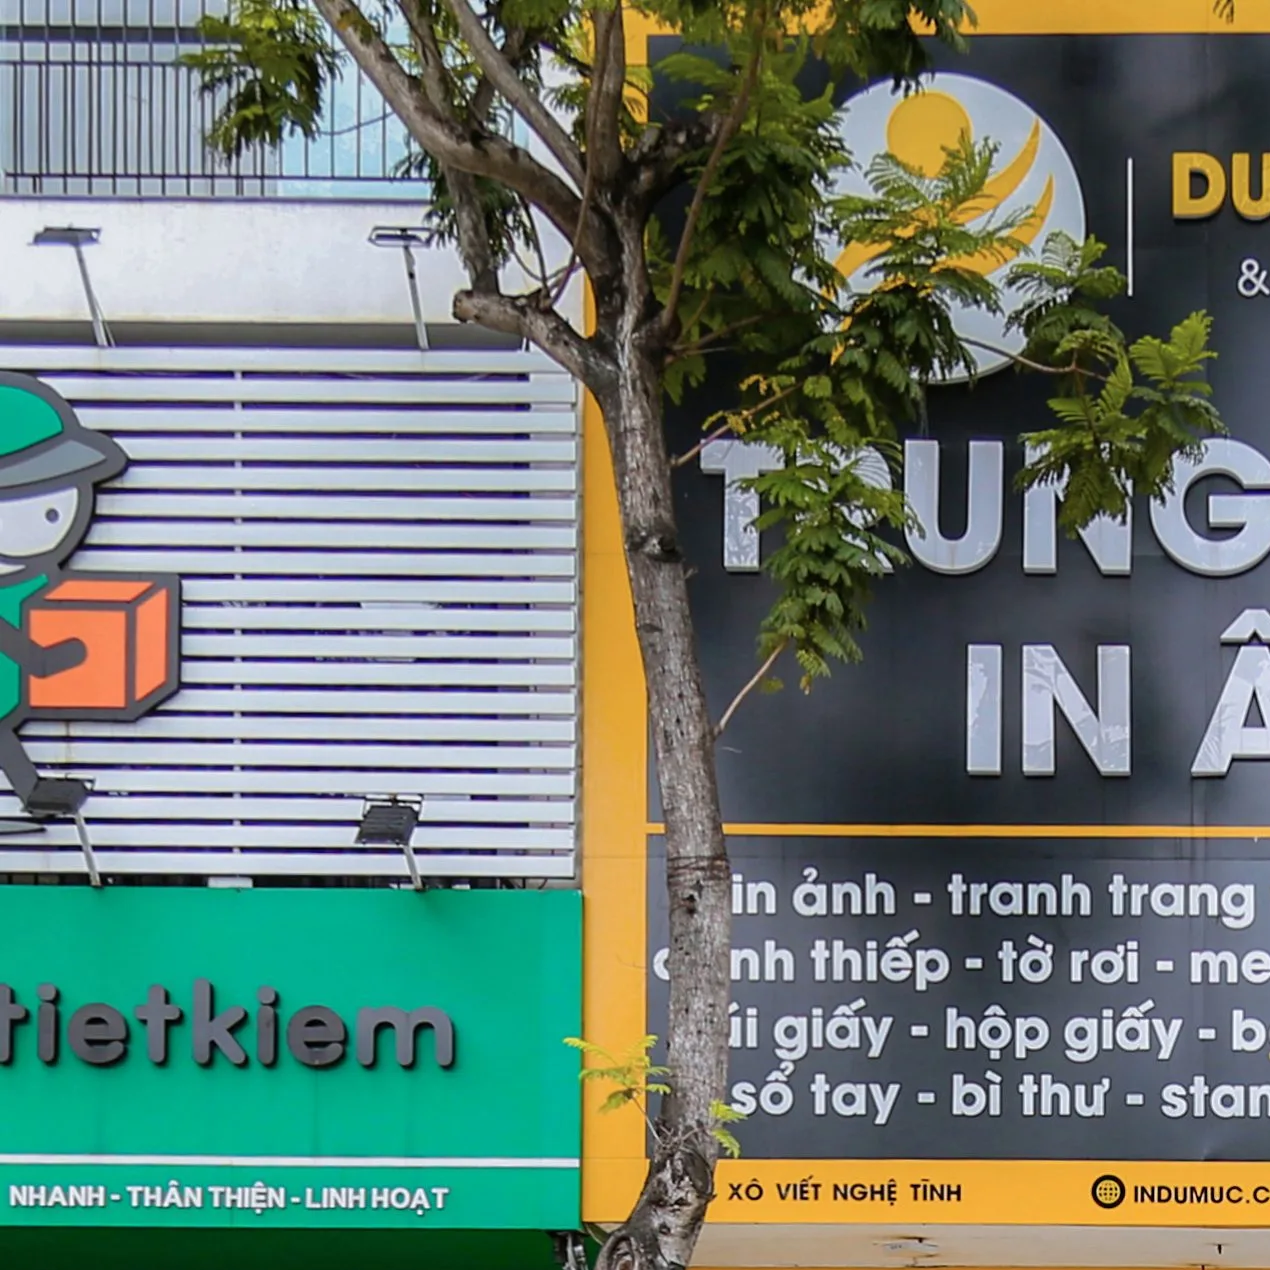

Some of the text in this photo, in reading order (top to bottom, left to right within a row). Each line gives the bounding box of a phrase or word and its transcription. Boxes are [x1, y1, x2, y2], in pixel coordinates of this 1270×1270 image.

[1238, 258, 1270, 297] &
[966, 643, 1132, 778] IN
[731, 873, 776, 916] in
[792, 867, 895, 917] ảnh
[947, 873, 1091, 918] tranh
[1109, 873, 1255, 928] trang
[811, 929, 951, 992] thiếp
[998, 934, 1053, 983] tờ
[1071, 940, 1139, 983] rơi
[773, 999, 894, 1062] giấy
[946, 1004, 1050, 1060] hộp
[1064, 999, 1183, 1062] giấy
[731, 1061, 794, 1116] sổ
[811, 1074, 901, 1125] tay
[952, 1069, 1002, 1117] bì
[1019, 1074, 1110, 1118] thư
[9, 1179, 449, 1216] NHANH THÂN THIỆN LINH HOẠT
[728, 1179, 763, 1201] XÔ
[776, 1175, 822, 1201] VIẾT
[833, 1179, 898, 1206] NGHỆ
